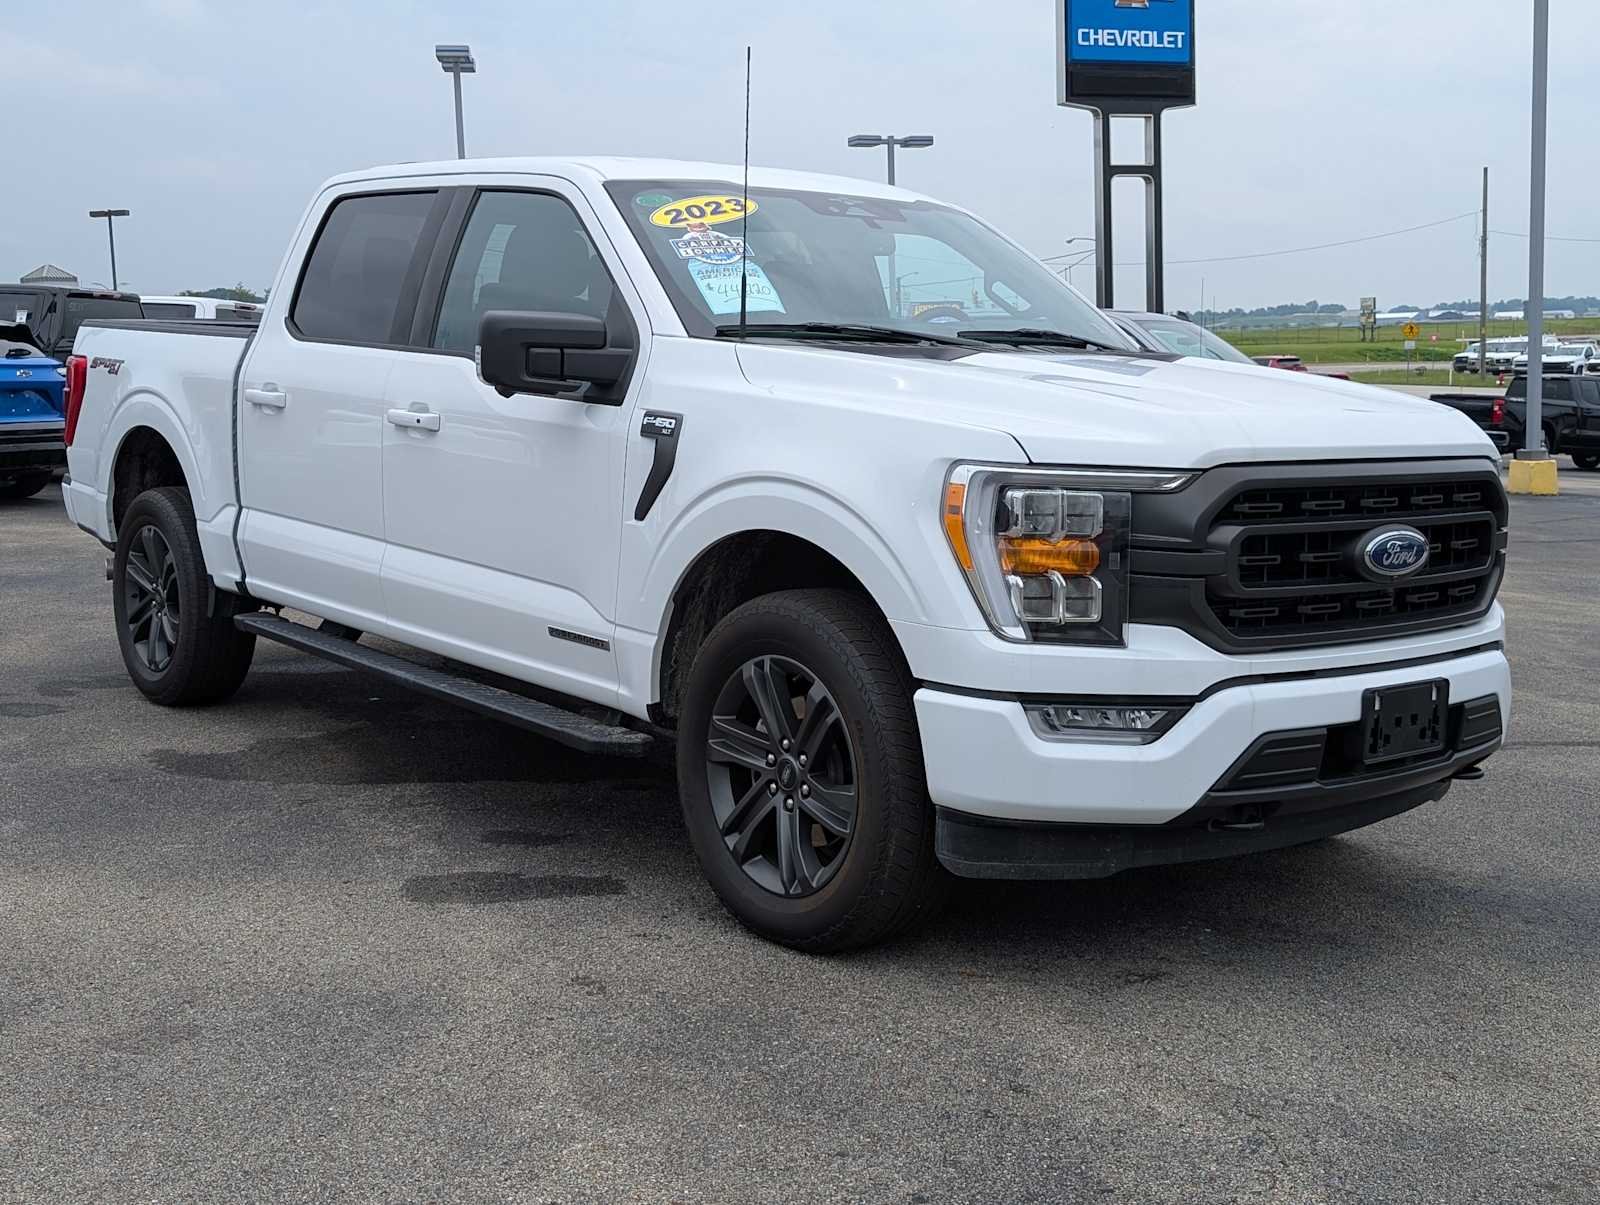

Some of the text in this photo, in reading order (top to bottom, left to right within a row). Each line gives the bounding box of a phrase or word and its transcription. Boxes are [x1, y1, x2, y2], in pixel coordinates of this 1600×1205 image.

[1077, 28, 1185, 48] CHEVROLET
[664, 198, 745, 224] 2023
[643, 416, 676, 429] F-150
[1383, 540, 1417, 565] Ford
